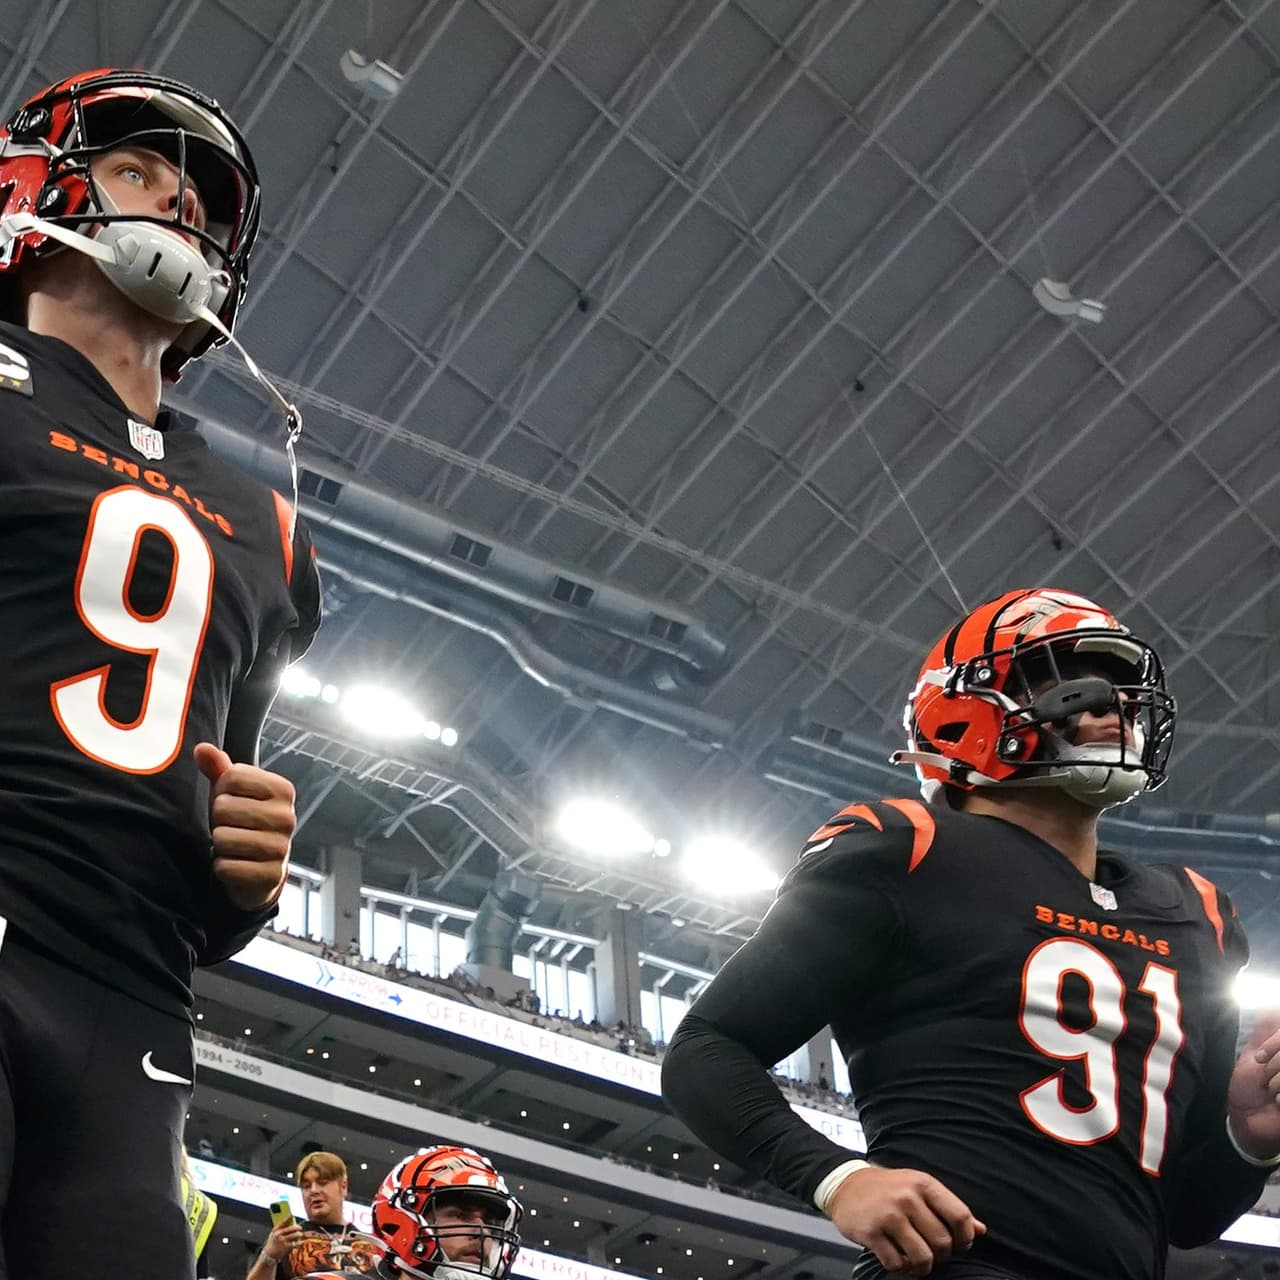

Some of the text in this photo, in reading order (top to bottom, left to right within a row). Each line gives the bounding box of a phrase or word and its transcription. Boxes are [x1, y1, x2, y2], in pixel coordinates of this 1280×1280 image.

[48, 430, 236, 538] BENGALS
[49, 483, 216, 776] 9
[1034, 903, 1172, 957] BENGALS
[426, 1000, 532, 1051] OFFICIAL
[538, 1035, 593, 1065] PEST
[1019, 935, 1186, 1178] 91
